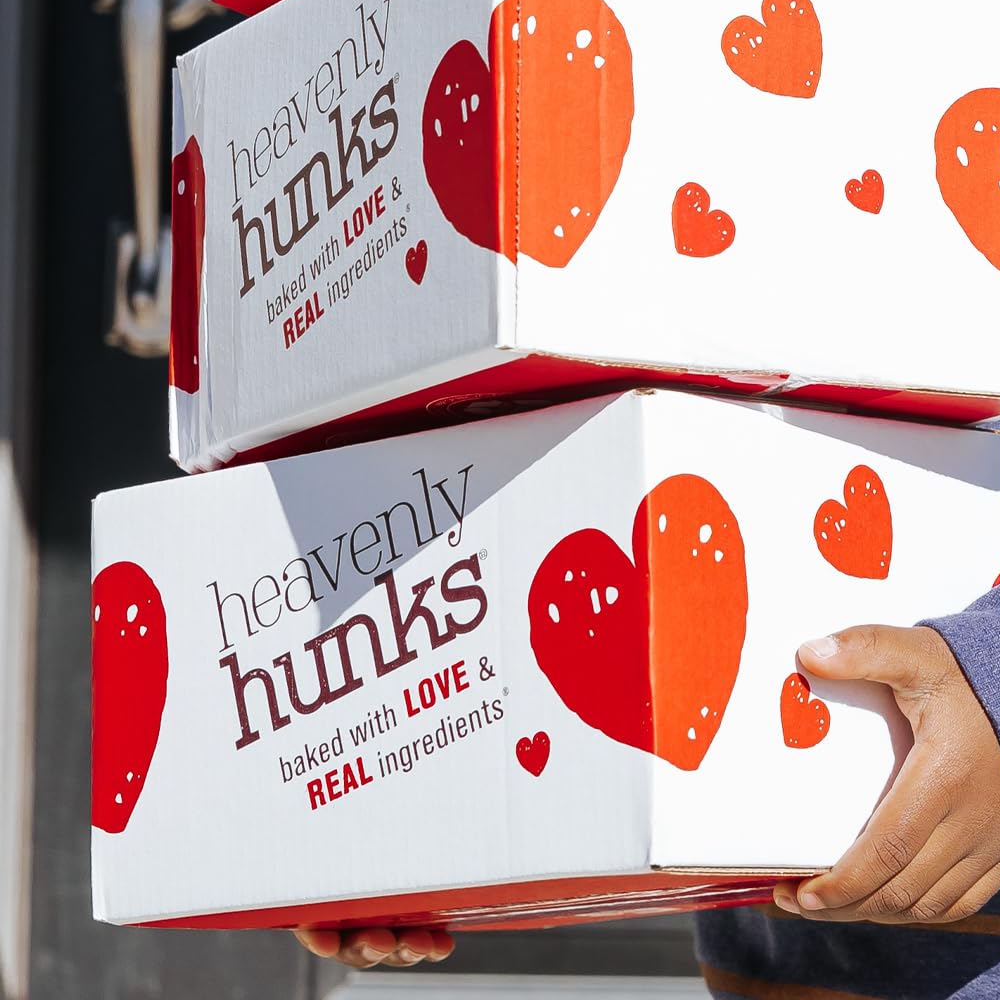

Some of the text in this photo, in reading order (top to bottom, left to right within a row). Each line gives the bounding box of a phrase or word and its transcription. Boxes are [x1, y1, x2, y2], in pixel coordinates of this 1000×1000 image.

[267, 176, 402, 324] baked with LOVE &
[282, 292, 325, 349] REAL
[206, 464, 474, 653] heavenly
[279, 657, 496, 783] baked with LOVE &
[306, 757, 374, 811] REAL
